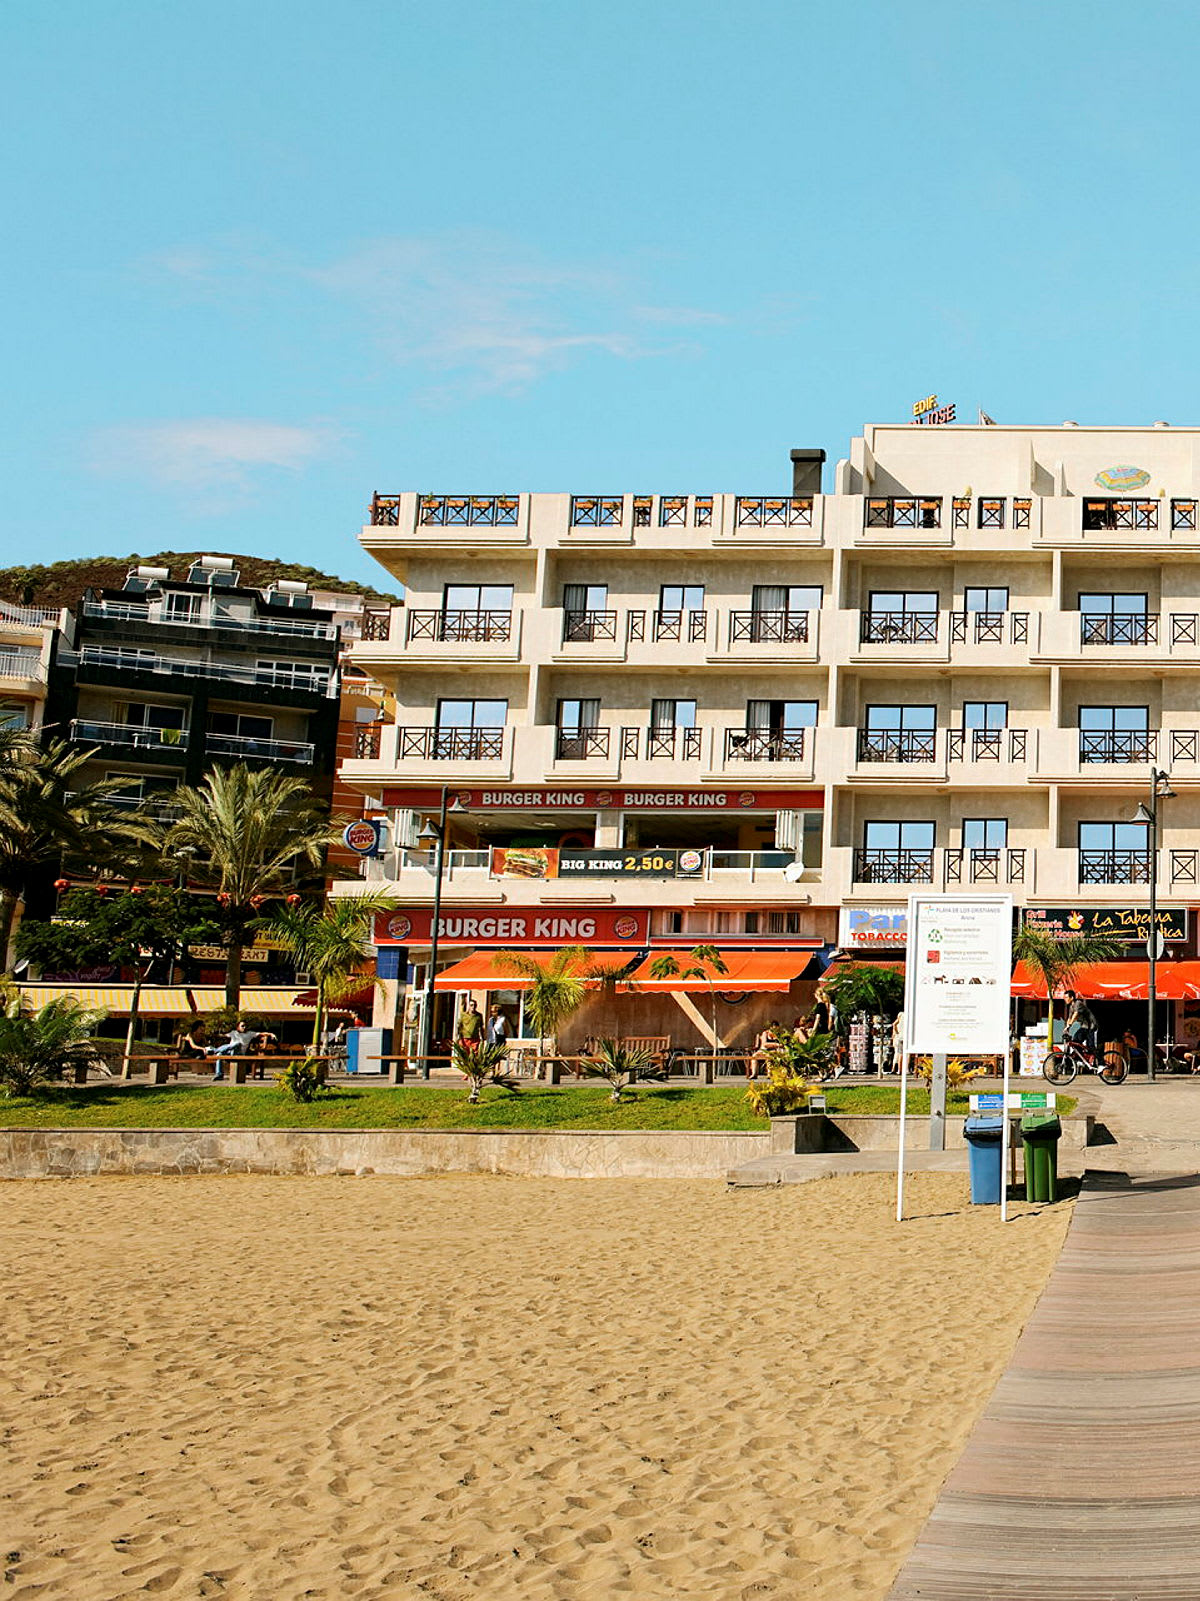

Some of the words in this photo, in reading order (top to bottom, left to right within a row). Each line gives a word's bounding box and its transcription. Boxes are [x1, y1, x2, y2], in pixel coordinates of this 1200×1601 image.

[913, 394, 938, 416] EDIF.
[482, 792, 542, 805] BURGER
[546, 792, 585, 805] KING
[624, 793, 684, 805] BURGER
[688, 793, 727, 805] KING
[350, 834, 375, 844] KING
[561, 859, 585, 870] BIG
[588, 859, 623, 870] KING
[850, 910, 906, 928] Par
[1092, 912, 1114, 928] La
[430, 918, 526, 937] BURGER
[534, 918, 596, 937] KING
[1137, 923, 1184, 939] Rtica
[190, 946, 267, 960] RESTARANT
